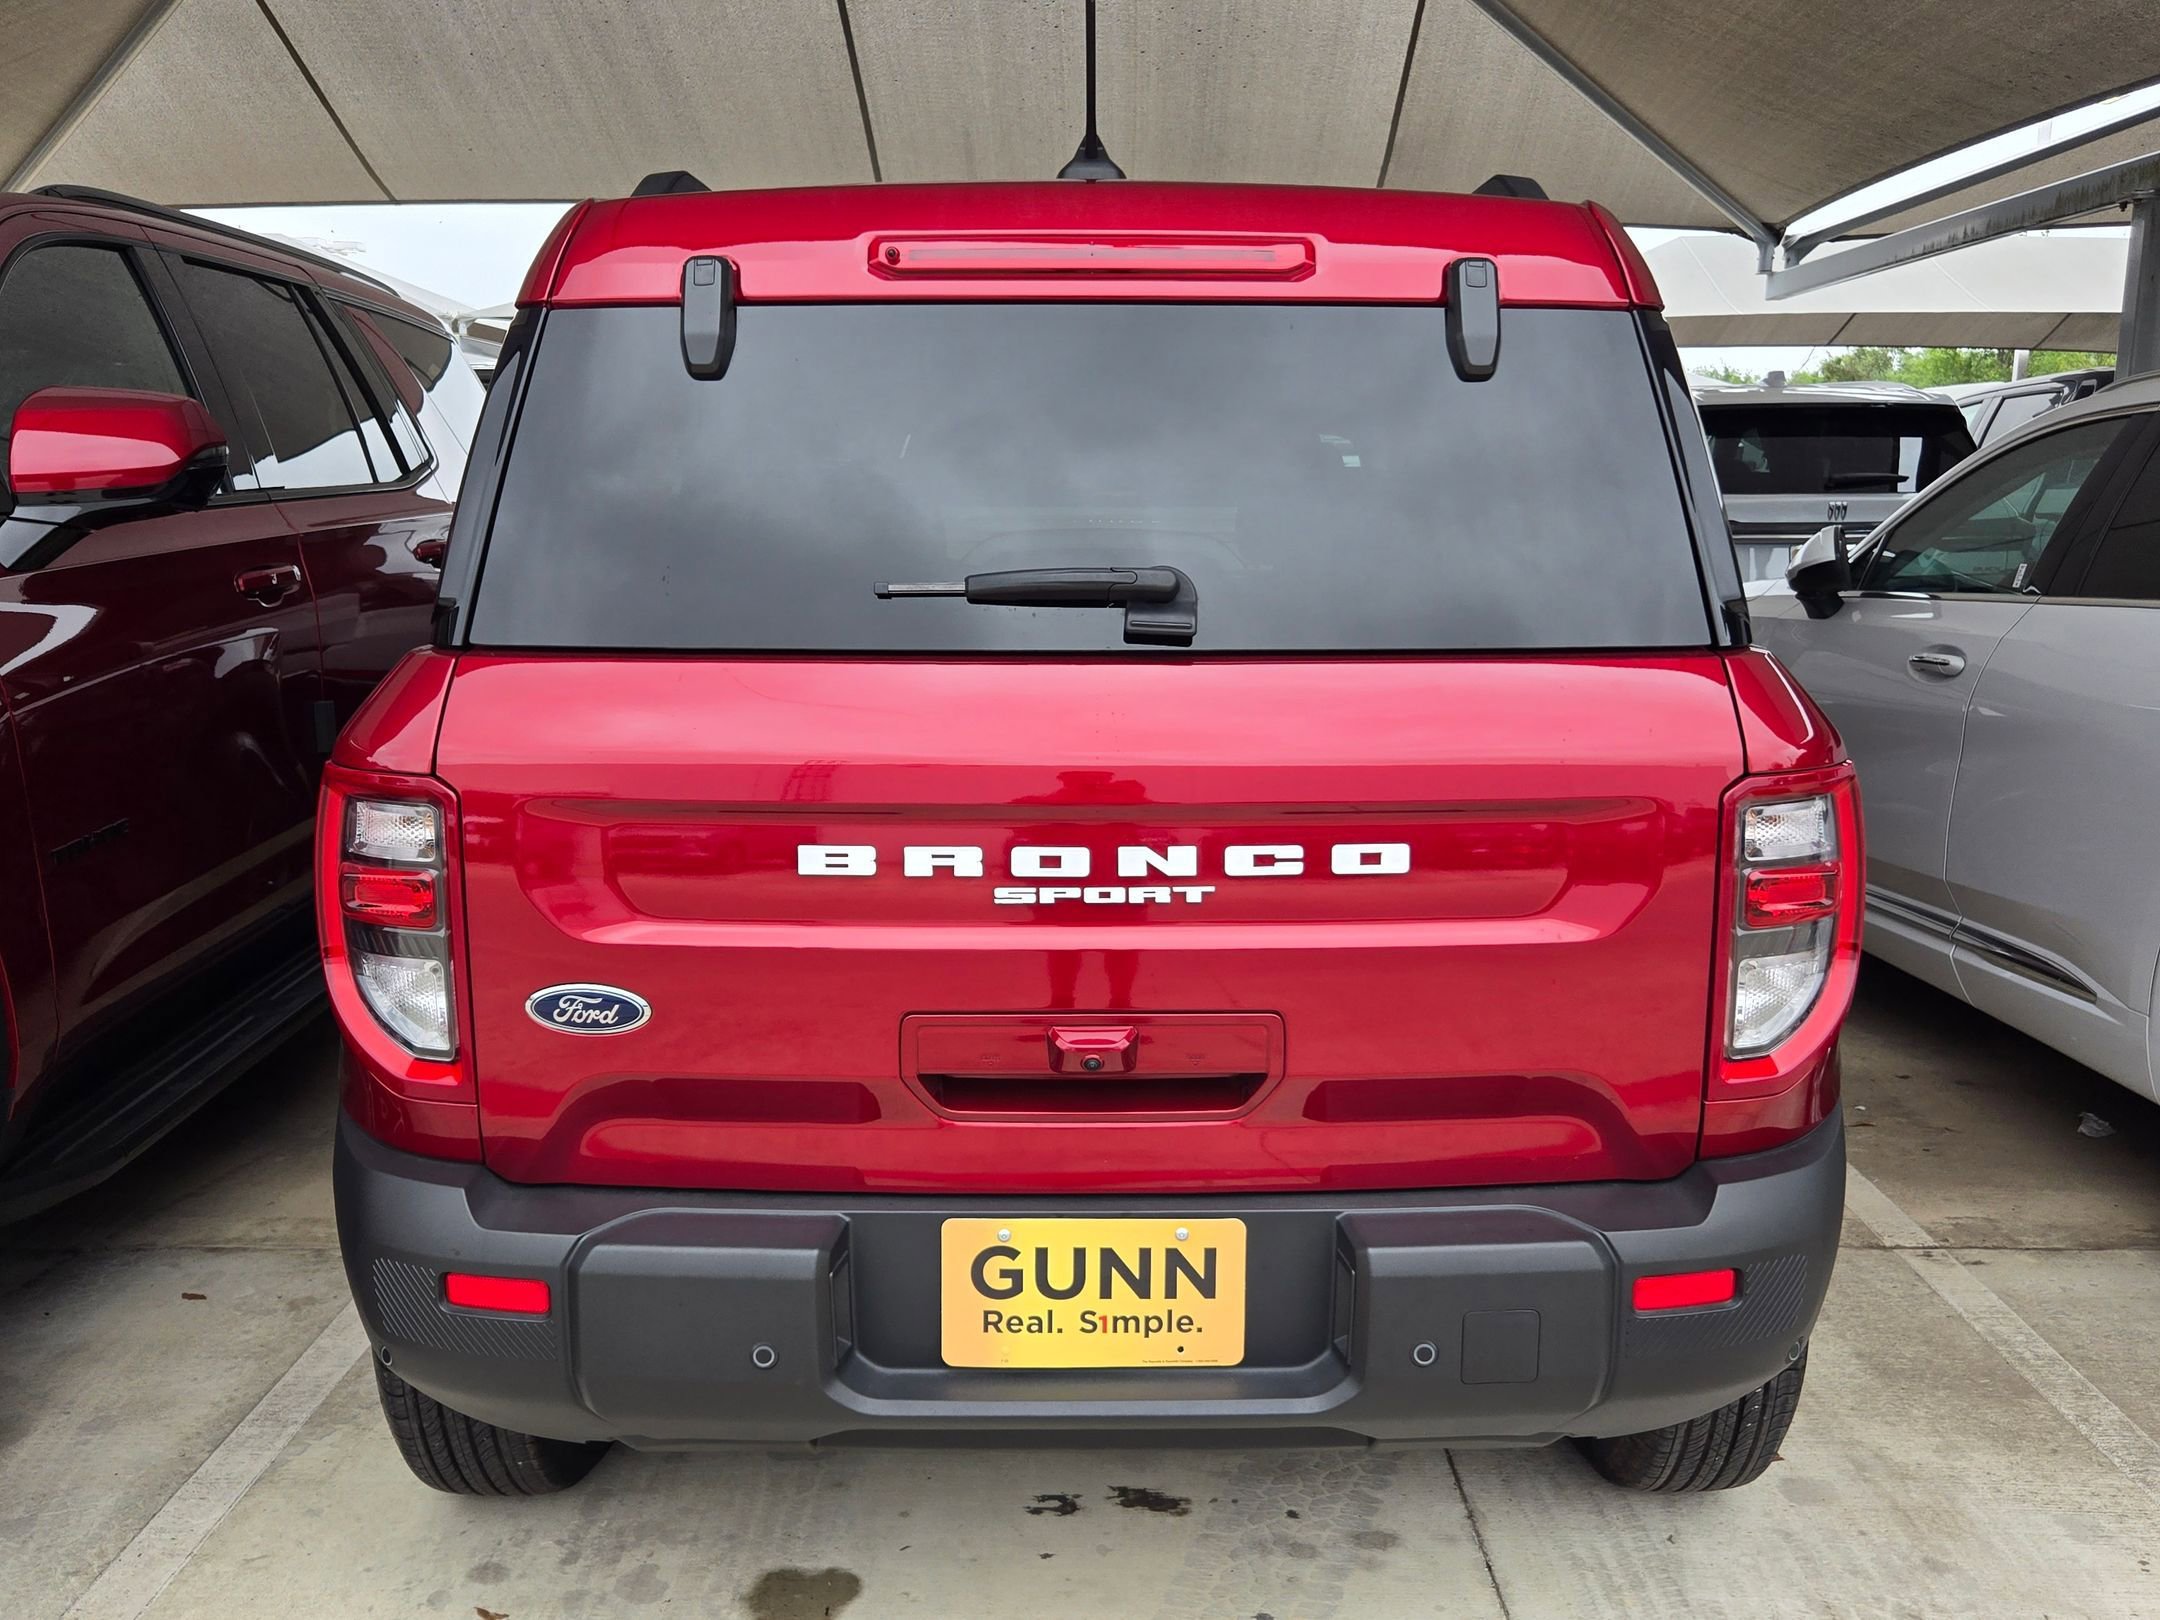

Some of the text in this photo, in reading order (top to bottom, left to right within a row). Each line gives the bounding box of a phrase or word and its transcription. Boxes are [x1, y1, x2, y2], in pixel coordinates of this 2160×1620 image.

[797, 842, 1411, 878] BRONCO
[993, 885, 1216, 905] SPORT
[552, 994, 619, 1025] Ford
[970, 1245, 1217, 1301] GUNN
[983, 1309, 1063, 1334] Real.
